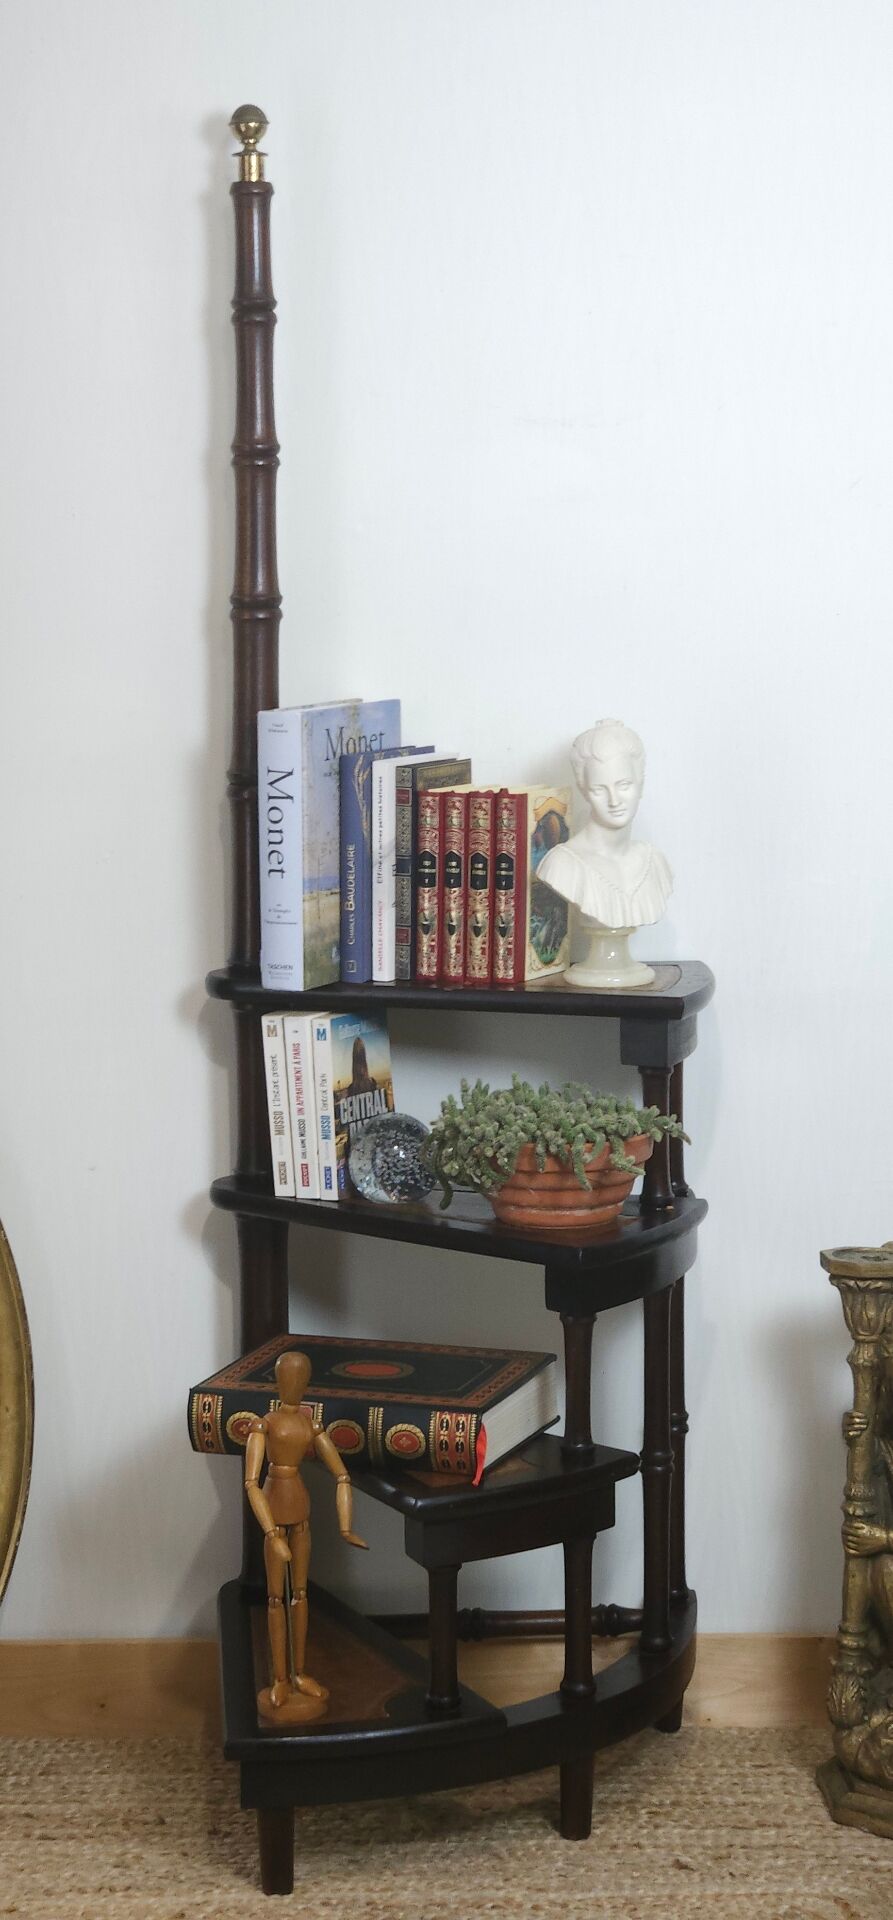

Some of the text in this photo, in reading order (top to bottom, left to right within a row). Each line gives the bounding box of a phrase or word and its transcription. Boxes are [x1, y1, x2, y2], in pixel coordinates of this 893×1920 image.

[323, 725, 386, 761] Monet
[266, 765, 295, 880] Monet
[345, 844, 355, 912] BAUDELAIRE
[273, 1111, 285, 1135] MUSSO
[340, 1088, 388, 1124] CENTRAL
[320, 1115, 332, 1140] MUSSO
